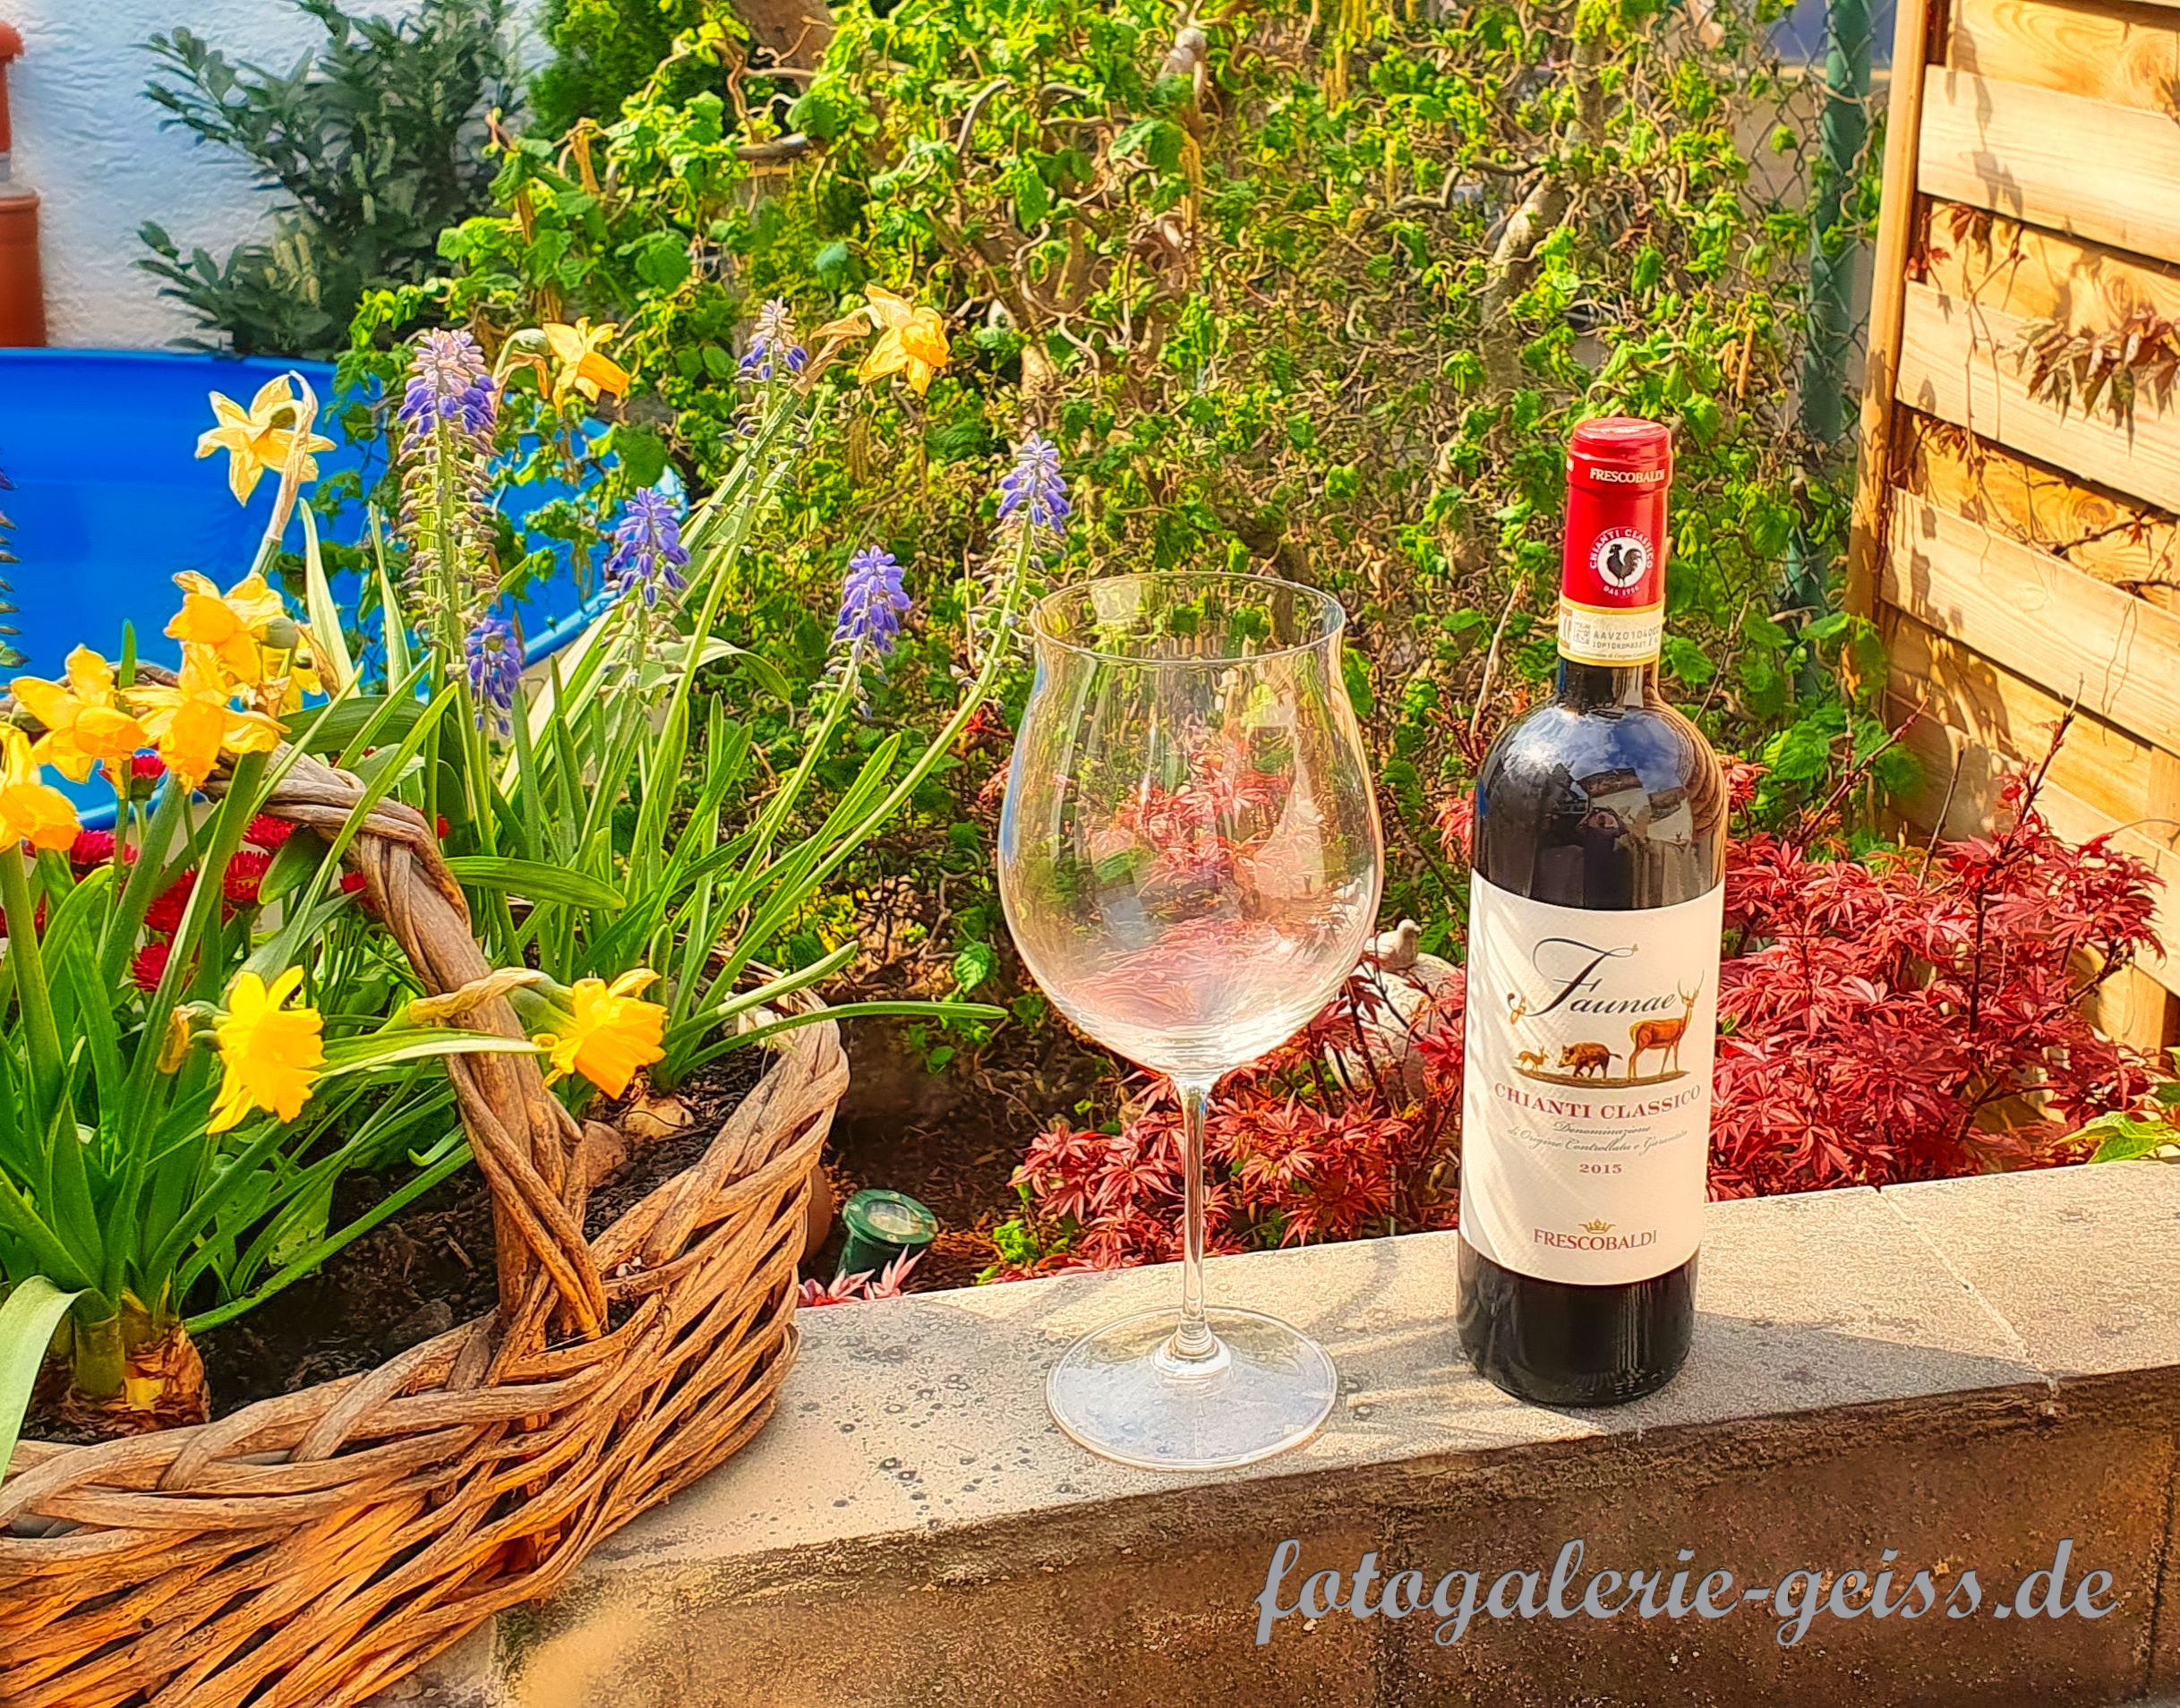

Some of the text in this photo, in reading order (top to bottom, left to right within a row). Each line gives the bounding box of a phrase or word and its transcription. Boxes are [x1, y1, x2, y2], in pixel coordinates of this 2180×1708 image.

[1590, 467, 1665, 483] FRESCOBALDI
[1589, 528, 1654, 569] CHIANTI CLASSICO
[1508, 937, 1676, 1018] Faunae
[1494, 1082, 1701, 1120] CHIANTI CLASSICO
[1519, 1129, 1563, 1150] Origine
[1565, 1134, 1632, 1152] Controllata
[1552, 1120, 1652, 1140] Denominazione
[1578, 1163, 1623, 1174] 2015
[1533, 1227, 1657, 1251] FRESCOBALDI
